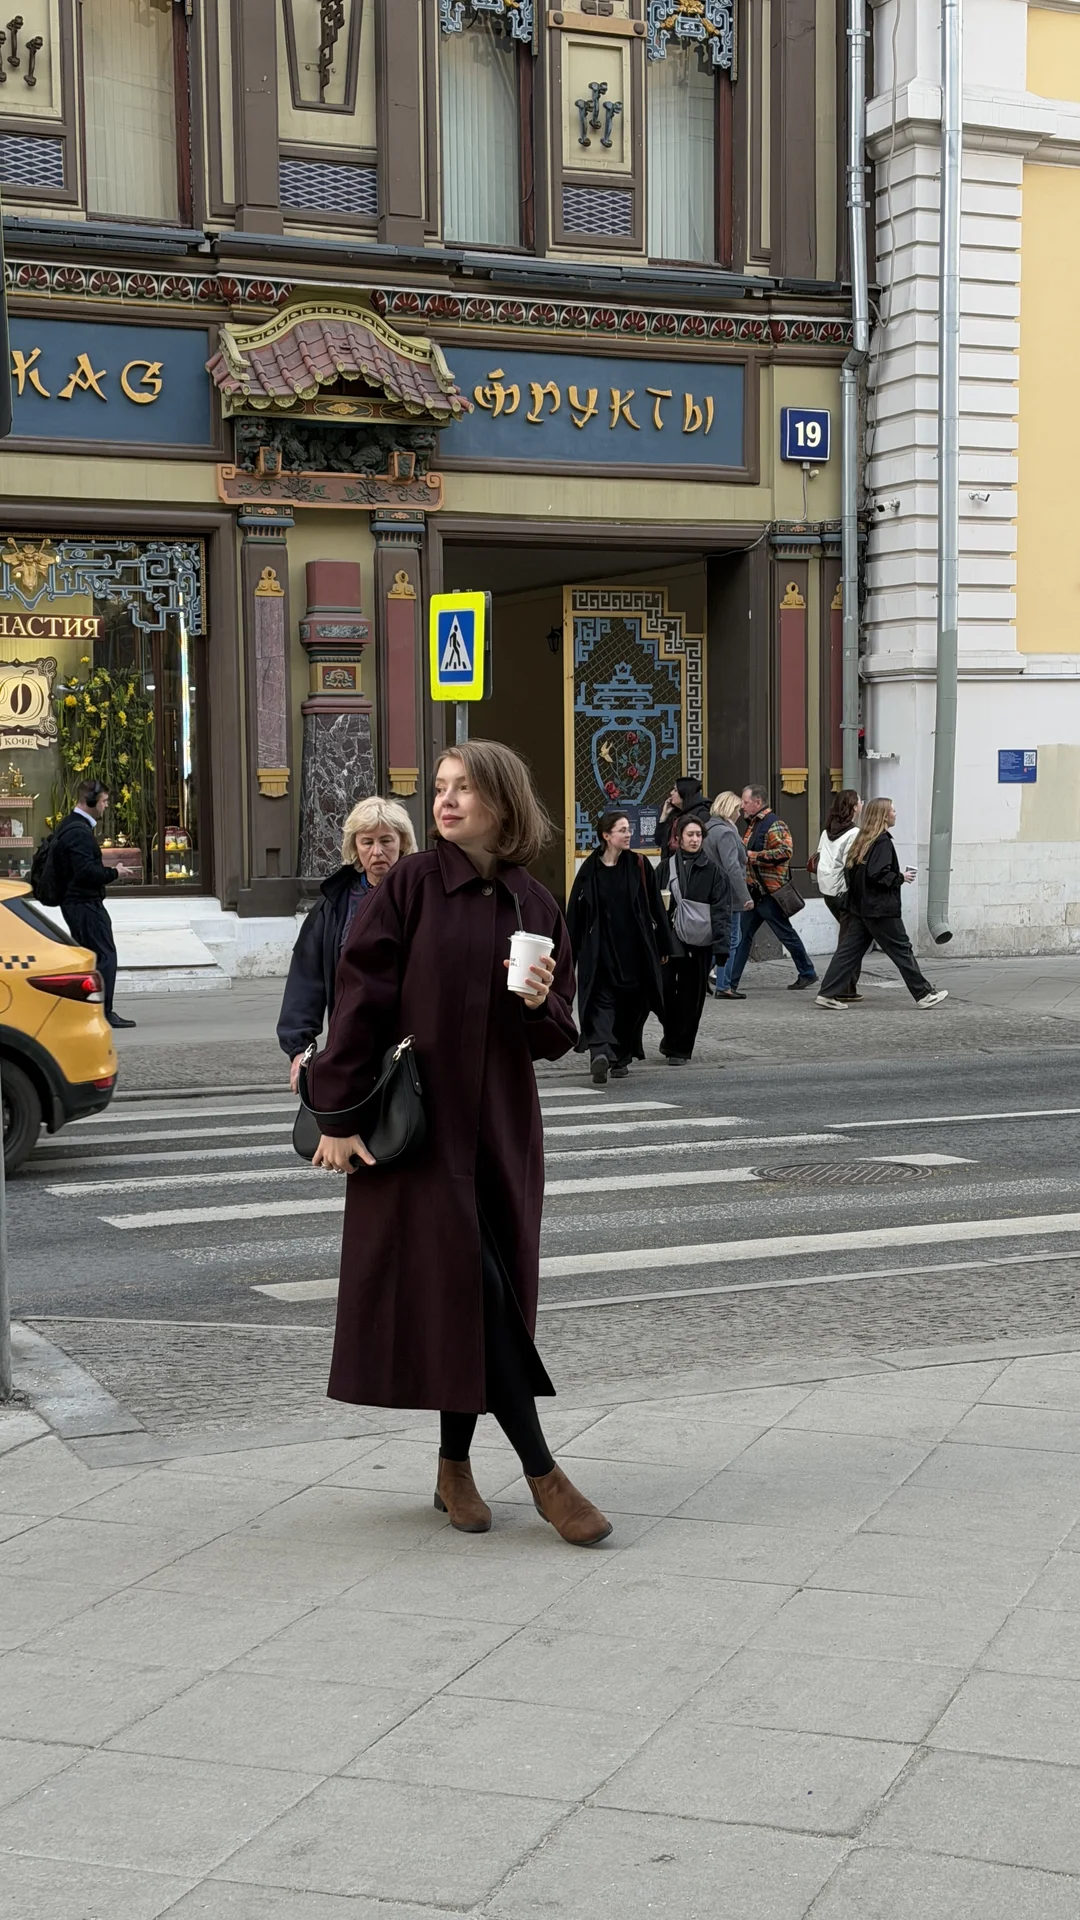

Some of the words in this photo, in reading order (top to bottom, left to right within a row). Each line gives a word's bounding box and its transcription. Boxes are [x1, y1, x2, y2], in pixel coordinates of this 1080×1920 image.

[474, 368, 714, 435] ФРУКТЫ
[794, 421, 822, 447] 19
[4, 736, 34, 746] КОФЕ
